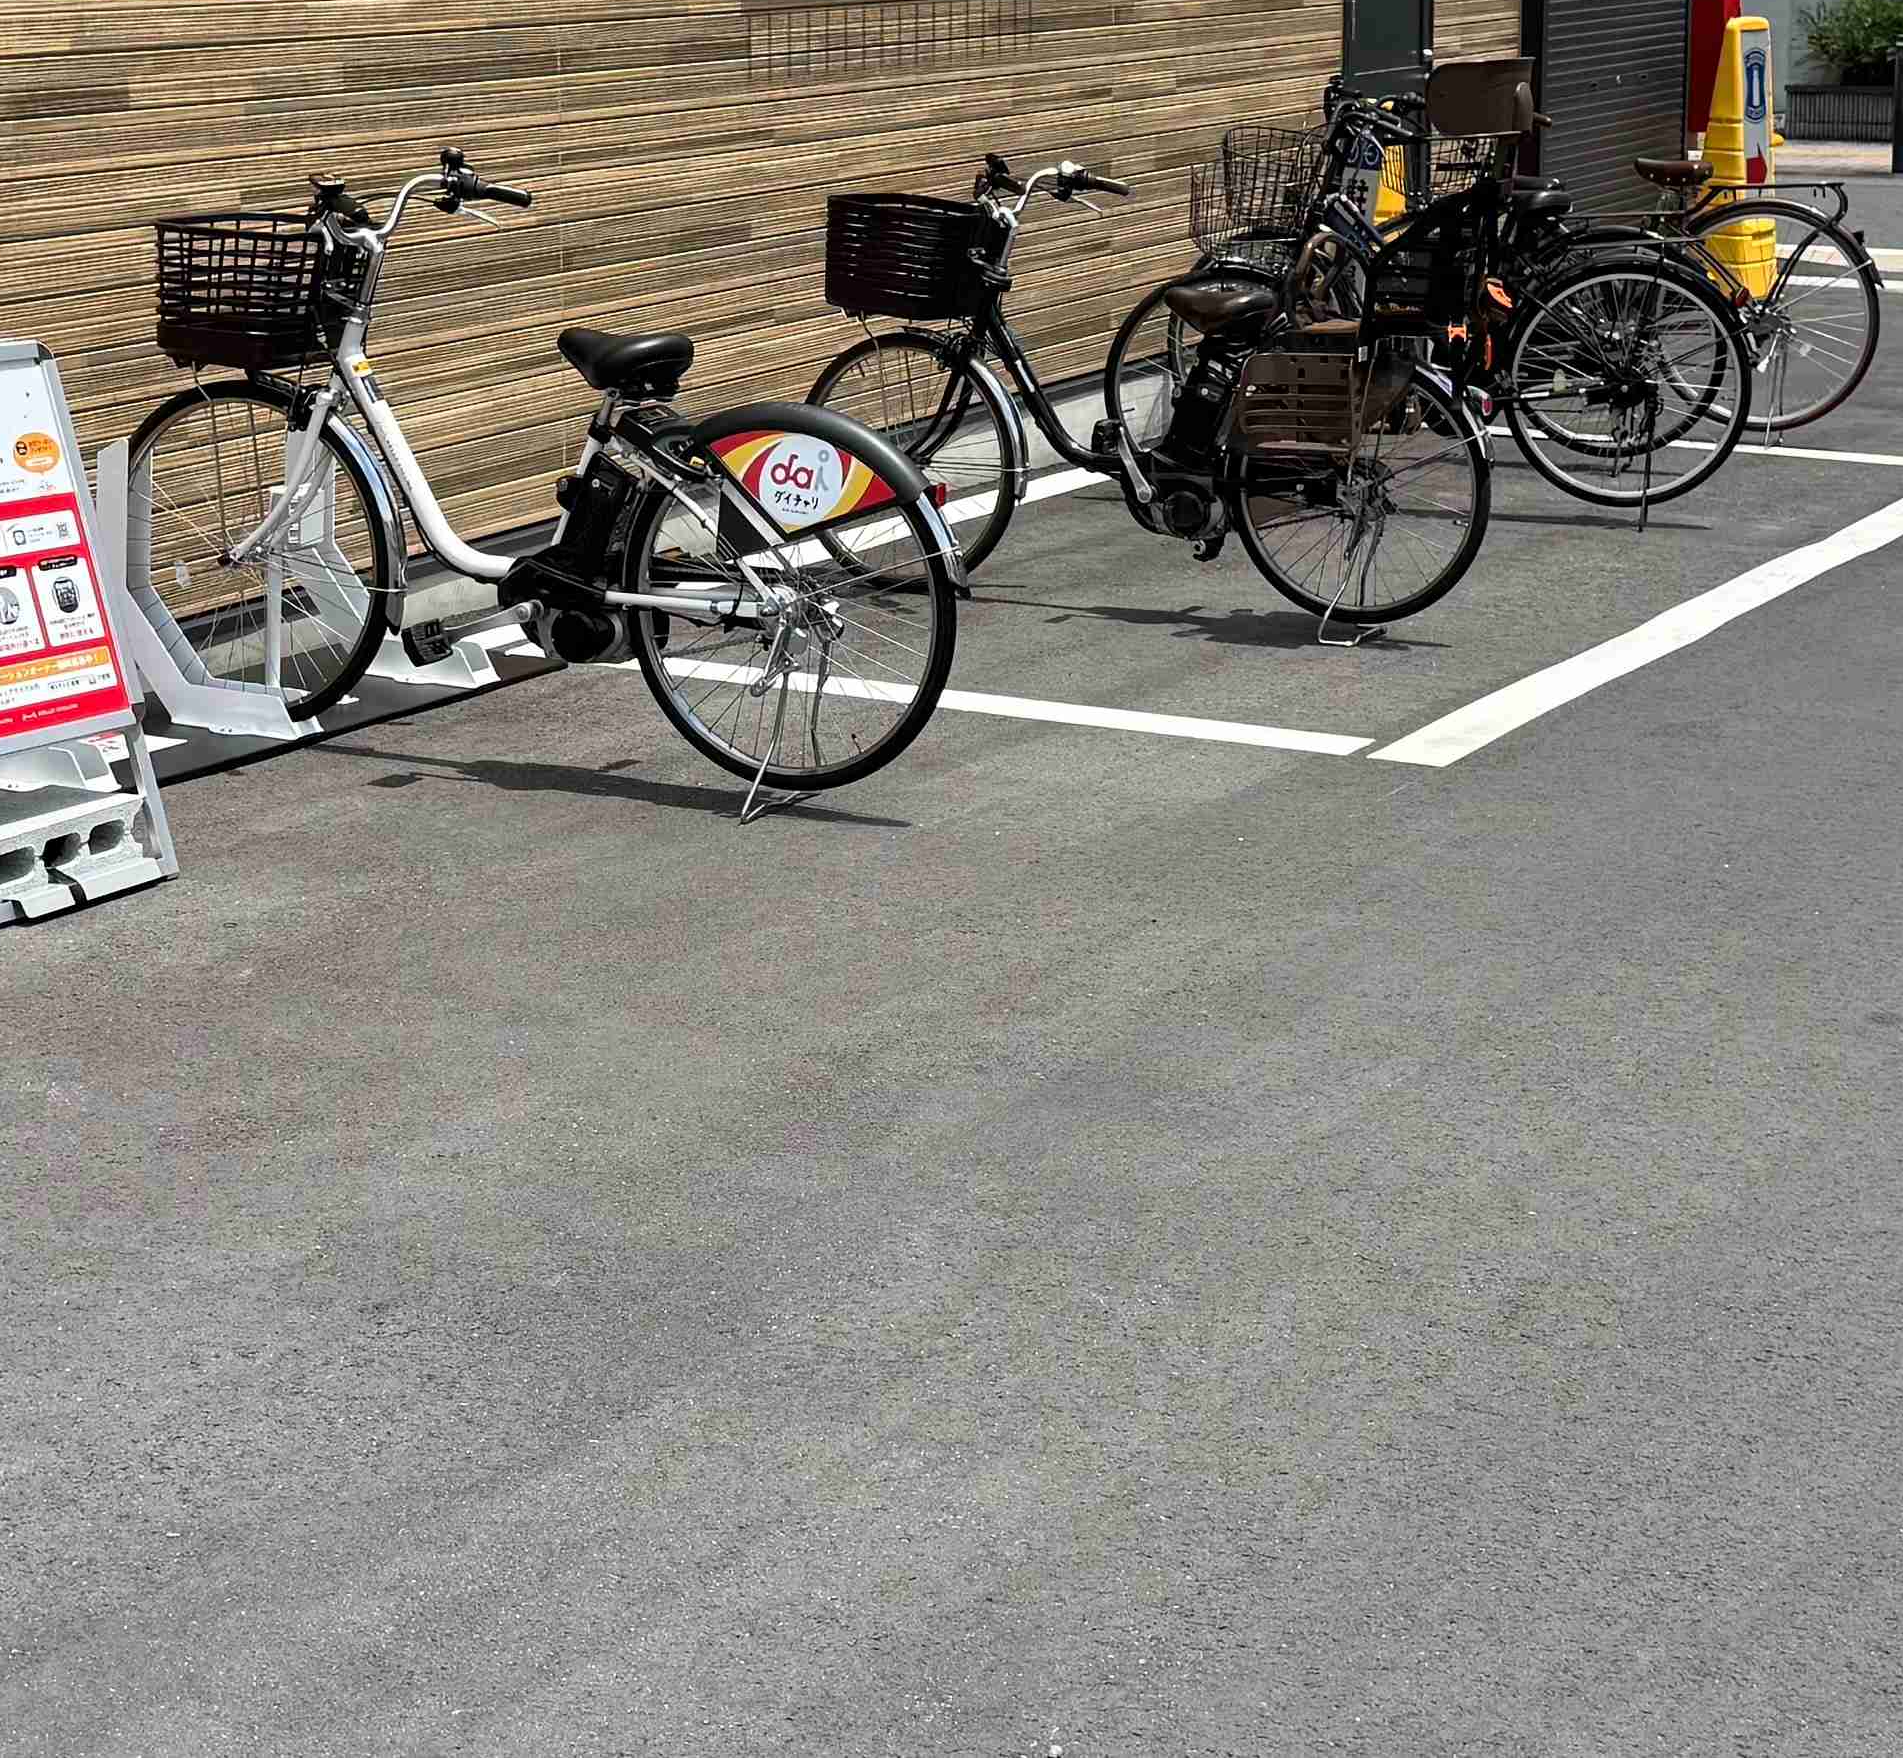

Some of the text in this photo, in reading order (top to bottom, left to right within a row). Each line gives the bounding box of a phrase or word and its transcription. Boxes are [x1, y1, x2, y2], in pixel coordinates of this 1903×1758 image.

[770, 449, 830, 492] dai
[774, 490, 819, 510] ダイチャリ
